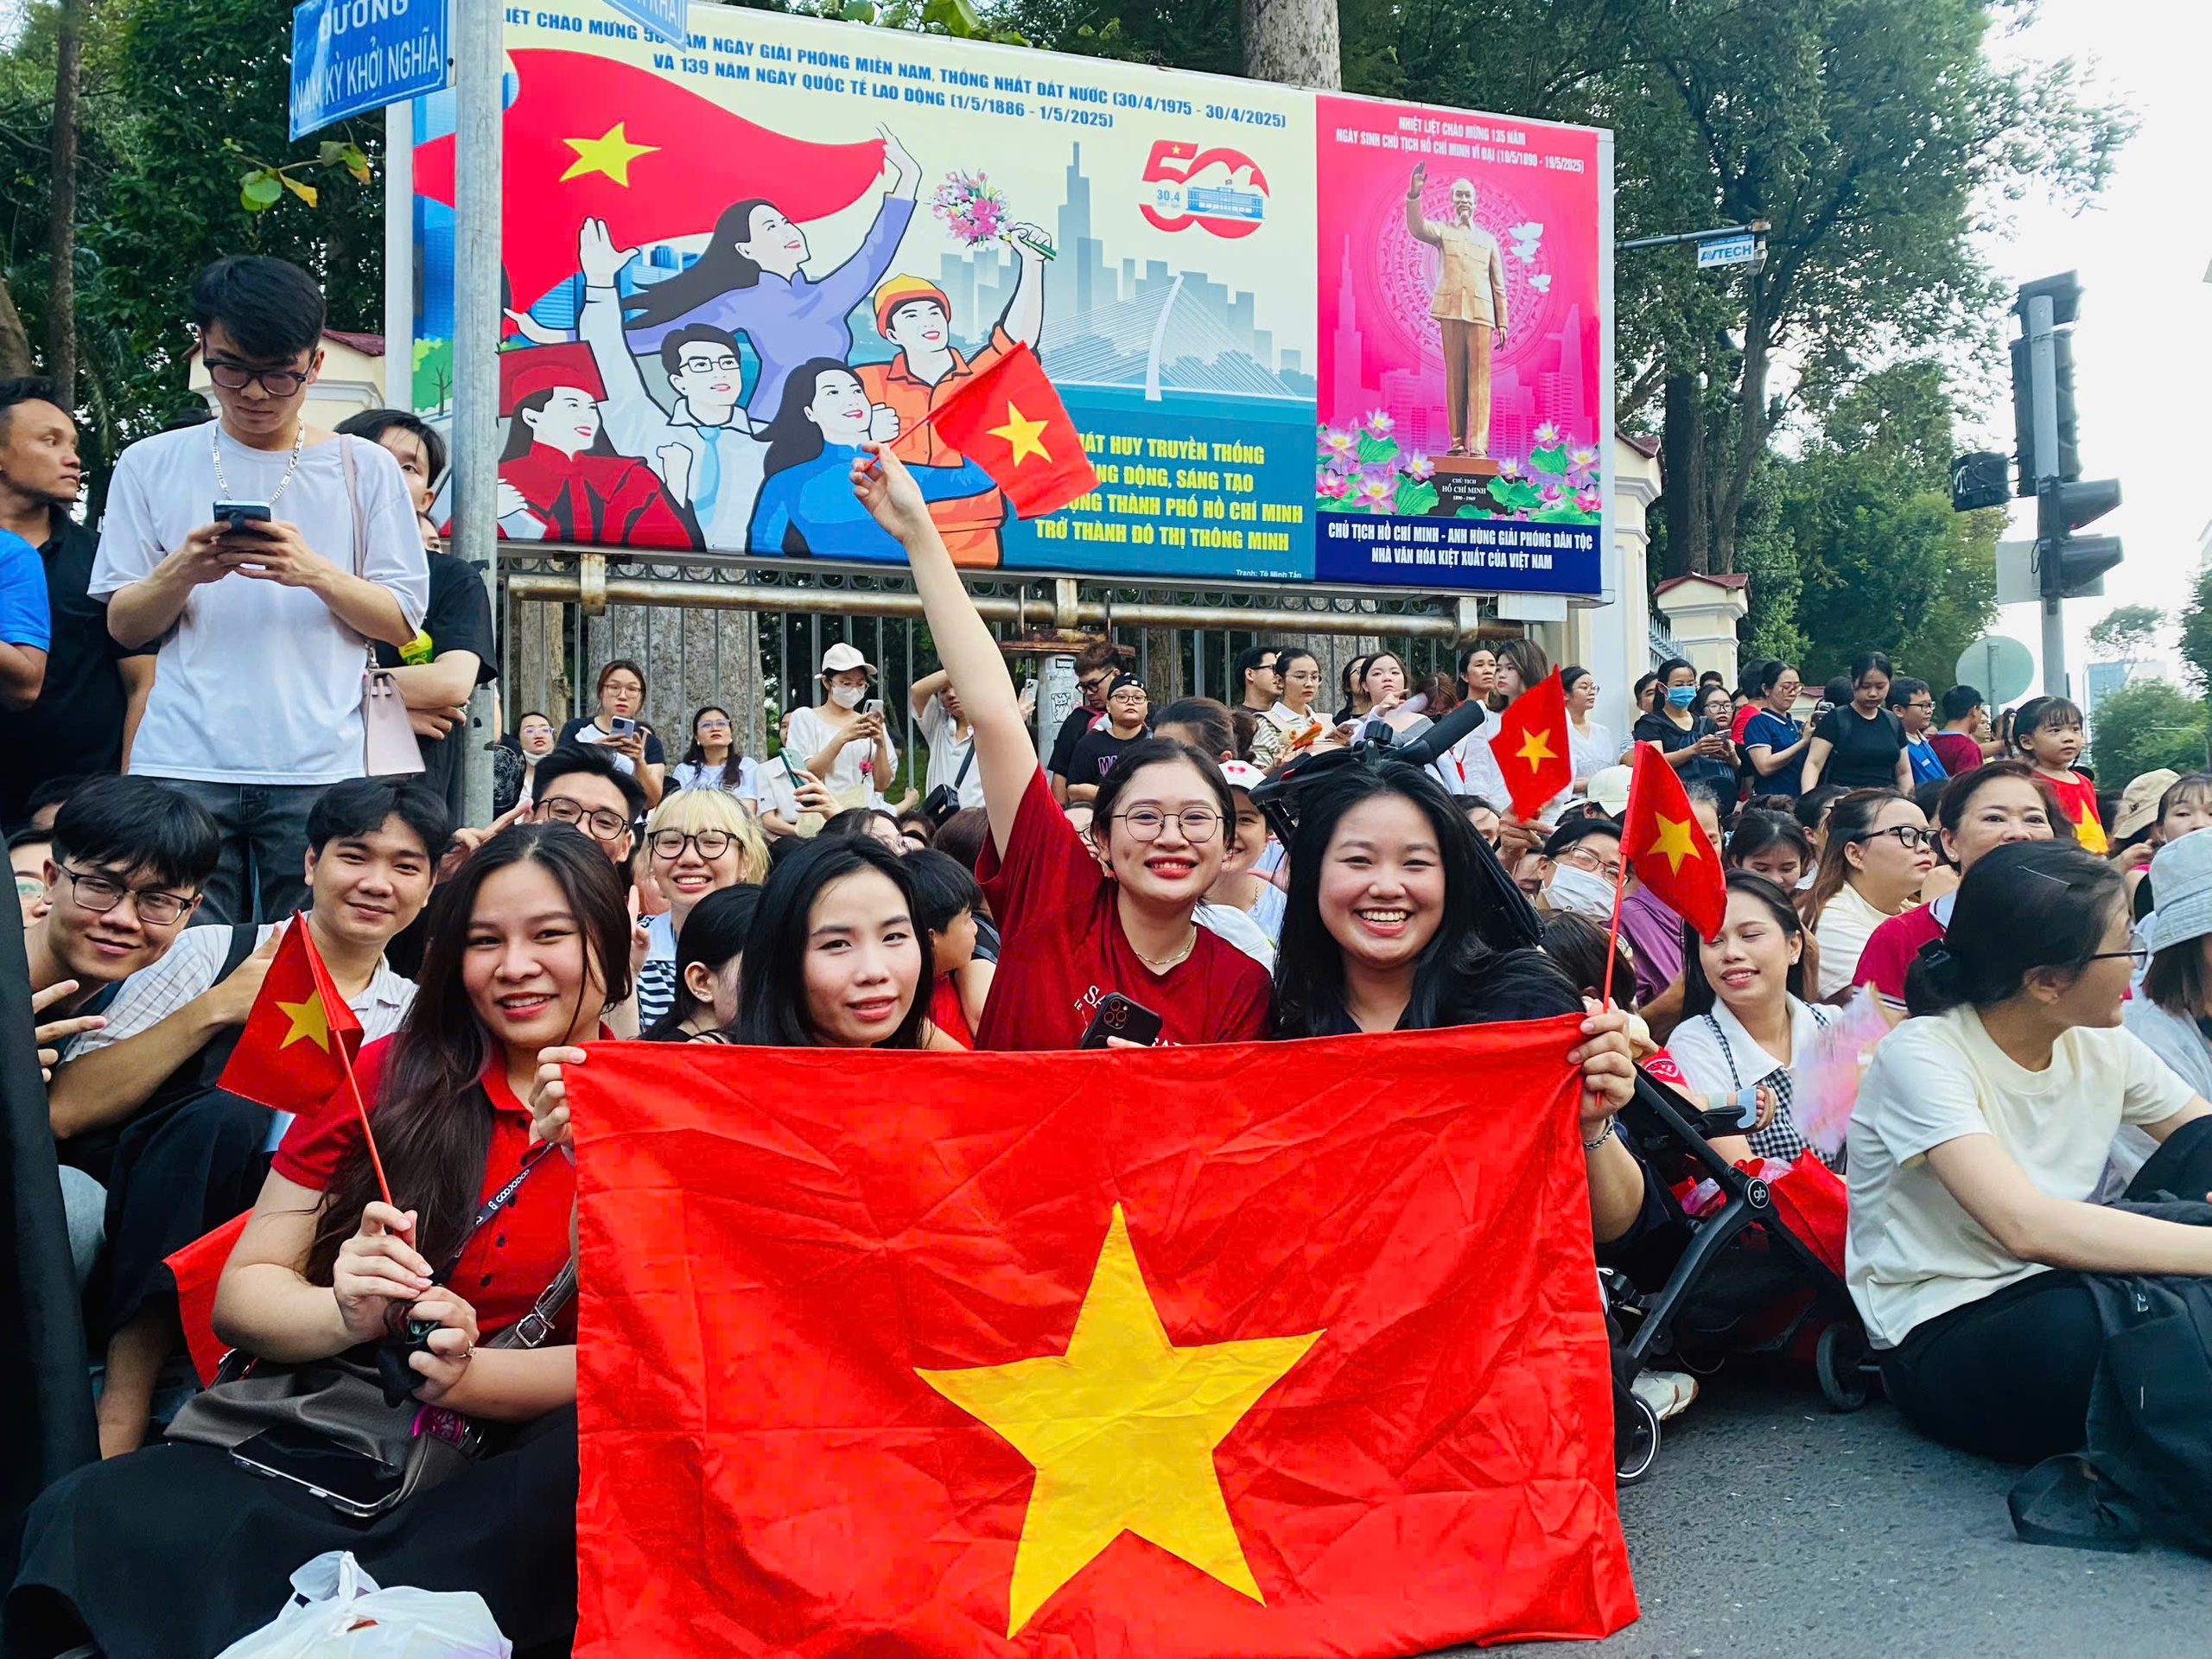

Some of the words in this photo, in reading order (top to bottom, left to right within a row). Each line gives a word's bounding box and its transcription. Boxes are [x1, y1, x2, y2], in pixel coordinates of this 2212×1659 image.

[295, 73, 322, 114] NAM
[325, 51, 343, 105] KỲ
[347, 35, 383, 97] KHỞI
[388, 27, 439, 84] NGHĨA
[503, 8, 531, 27] IỆT
[537, 11, 582, 32] CHÀO
[588, 16, 638, 40] MỪNG
[713, 36, 754, 56] NGÀY
[760, 42, 791, 62] GIẢI
[798, 48, 850, 69] PHÓNG
[855, 55, 893, 75] MIỀN
[899, 63, 935, 83] NAM,
[940, 67, 988, 89] THỐNG
[995, 73, 1032, 94] NHẤT
[1037, 79, 1065, 98] ĐẤT
[1069, 86, 1108, 105] NƯỚC
[1113, 92, 1192, 115] (30/4/1975
[1205, 105, 1286, 128] 30/4/2025)
[653, 53, 675, 70] VÀ
[680, 58, 709, 75] 139
[715, 61, 750, 79] NĂM
[756, 68, 798, 86] NGÀY
[802, 72, 845, 92] QUỐC
[849, 77, 867, 96] TẾ
[872, 83, 899, 100] LAO
[904, 86, 945, 106] ĐỘNG
[950, 94, 1025, 117] (1/5/1886
[1039, 106, 1113, 128] 1/5/2025)
[1399, 116, 1422, 134] NHIỆT
[1424, 118, 1440, 137] LIỆT
[1442, 121, 1464, 137] CHÀO
[1465, 124, 1490, 141] MỪNG
[1491, 129, 1505, 143] 135
[1336, 127, 1358, 144] NGÀY
[1361, 131, 1380, 146] SINH
[1382, 131, 1399, 149] CHỦ
[1400, 137, 1419, 153] TỊCH
[1421, 137, 1431, 153] HỒ
[1433, 139, 1447, 155] CHÍ
[1449, 143, 1470, 157] MINH
[1481, 147, 1495, 163] ĐẠI
[1497, 149, 1538, 167] (19/5/1890
[1544, 156, 1585, 175] 19/5/2025)
[1157, 188, 1180, 201] 30.4
[1700, 245, 1752, 262] AVTECH
[1078, 431, 1105, 454] ÁT
[1110, 435, 1143, 456] HUY
[1147, 435, 1208, 461] TRUYỀN
[1211, 439, 1265, 464] THỐNG
[1123, 464, 1172, 489] ĐỘNG,
[1176, 467, 1219, 490] SÁNG
[1224, 473, 1254, 494] TẠO
[1442, 483, 1452, 493] HỒ
[1453, 485, 1466, 493] CHÍ
[1107, 493, 1160, 515] THÀNH
[1166, 493, 1198, 518] PHỐ
[1203, 495, 1224, 519] HỒ
[1230, 500, 1257, 521] CHÍ
[1262, 504, 1303, 523] MINH
[1035, 516, 1068, 539] TRỞ
[1072, 519, 1127, 543] THÀNH
[1131, 523, 1154, 544] ĐÔ
[1159, 525, 1185, 549] THỊ
[1190, 526, 1243, 549] THÔNG
[1248, 531, 1289, 550] MINH
[1328, 519, 1349, 538] CHỦ
[1351, 524, 1375, 542] TỊCH
[1377, 520, 1391, 541] HỒ
[1394, 524, 1411, 542] CHÍ
[1414, 526, 1439, 543] MINH
[1447, 528, 1467, 543] ANH
[1470, 526, 1496, 545] HÙNG
[1498, 527, 1517, 546] GIẢI
[1520, 530, 1551, 548] PHÓNG
[1554, 531, 1572, 549] DÂN
[1574, 532, 1592, 552] TỘC
[1371, 545, 1392, 563] NHÀ
[1394, 546, 1414, 564] VĂN
[1416, 547, 1436, 564] HÓA
[1438, 548, 1459, 568] KIỆT
[1461, 546, 1485, 567] XUẤT
[1488, 549, 1507, 568] CỦA
[1509, 550, 1529, 570] VIỆT
[1531, 554, 1552, 569] NAM
